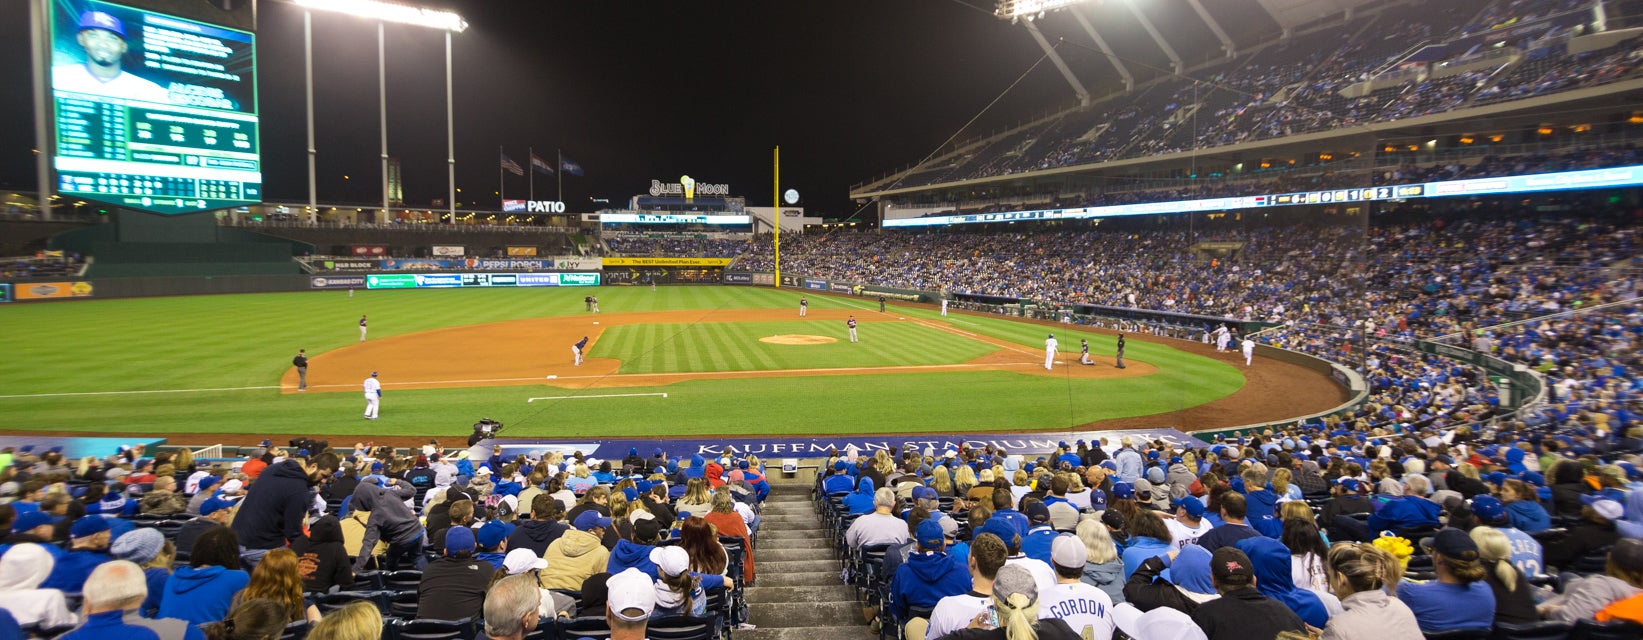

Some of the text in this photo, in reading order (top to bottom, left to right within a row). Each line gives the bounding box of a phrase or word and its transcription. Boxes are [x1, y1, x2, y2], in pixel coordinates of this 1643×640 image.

[650, 180, 729, 196] BLUE MOON
[527, 200, 566, 213] PATIO
[698, 438, 1060, 454] KAUFFMAN STADIUM
[190, 483, 198, 493] 7
[1050, 598, 1105, 620] GORDON
